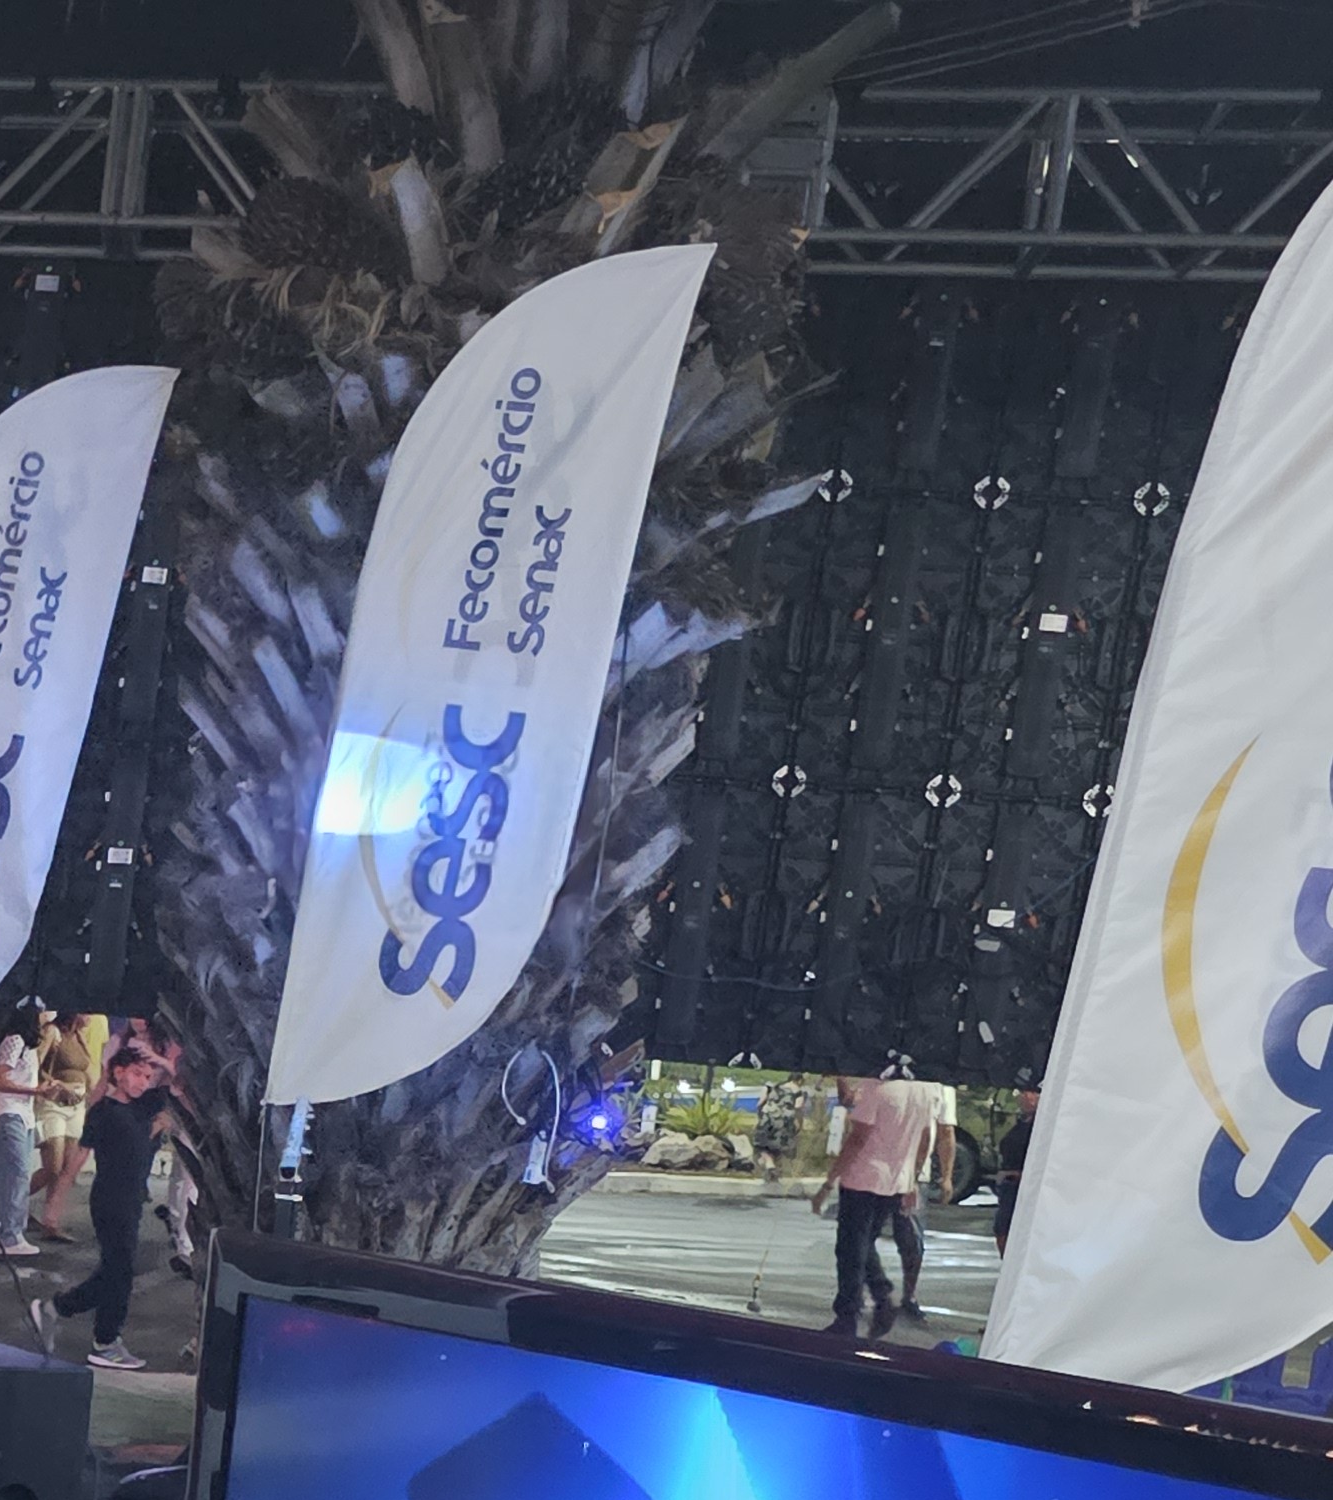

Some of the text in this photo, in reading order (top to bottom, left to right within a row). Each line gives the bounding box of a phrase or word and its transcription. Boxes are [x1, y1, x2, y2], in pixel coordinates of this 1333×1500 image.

[442, 367, 541, 652] Fecomércio
[507, 505, 572, 657] Senac
[14, 566, 68, 691] Senac
[379, 703, 526, 1004] Sesc
